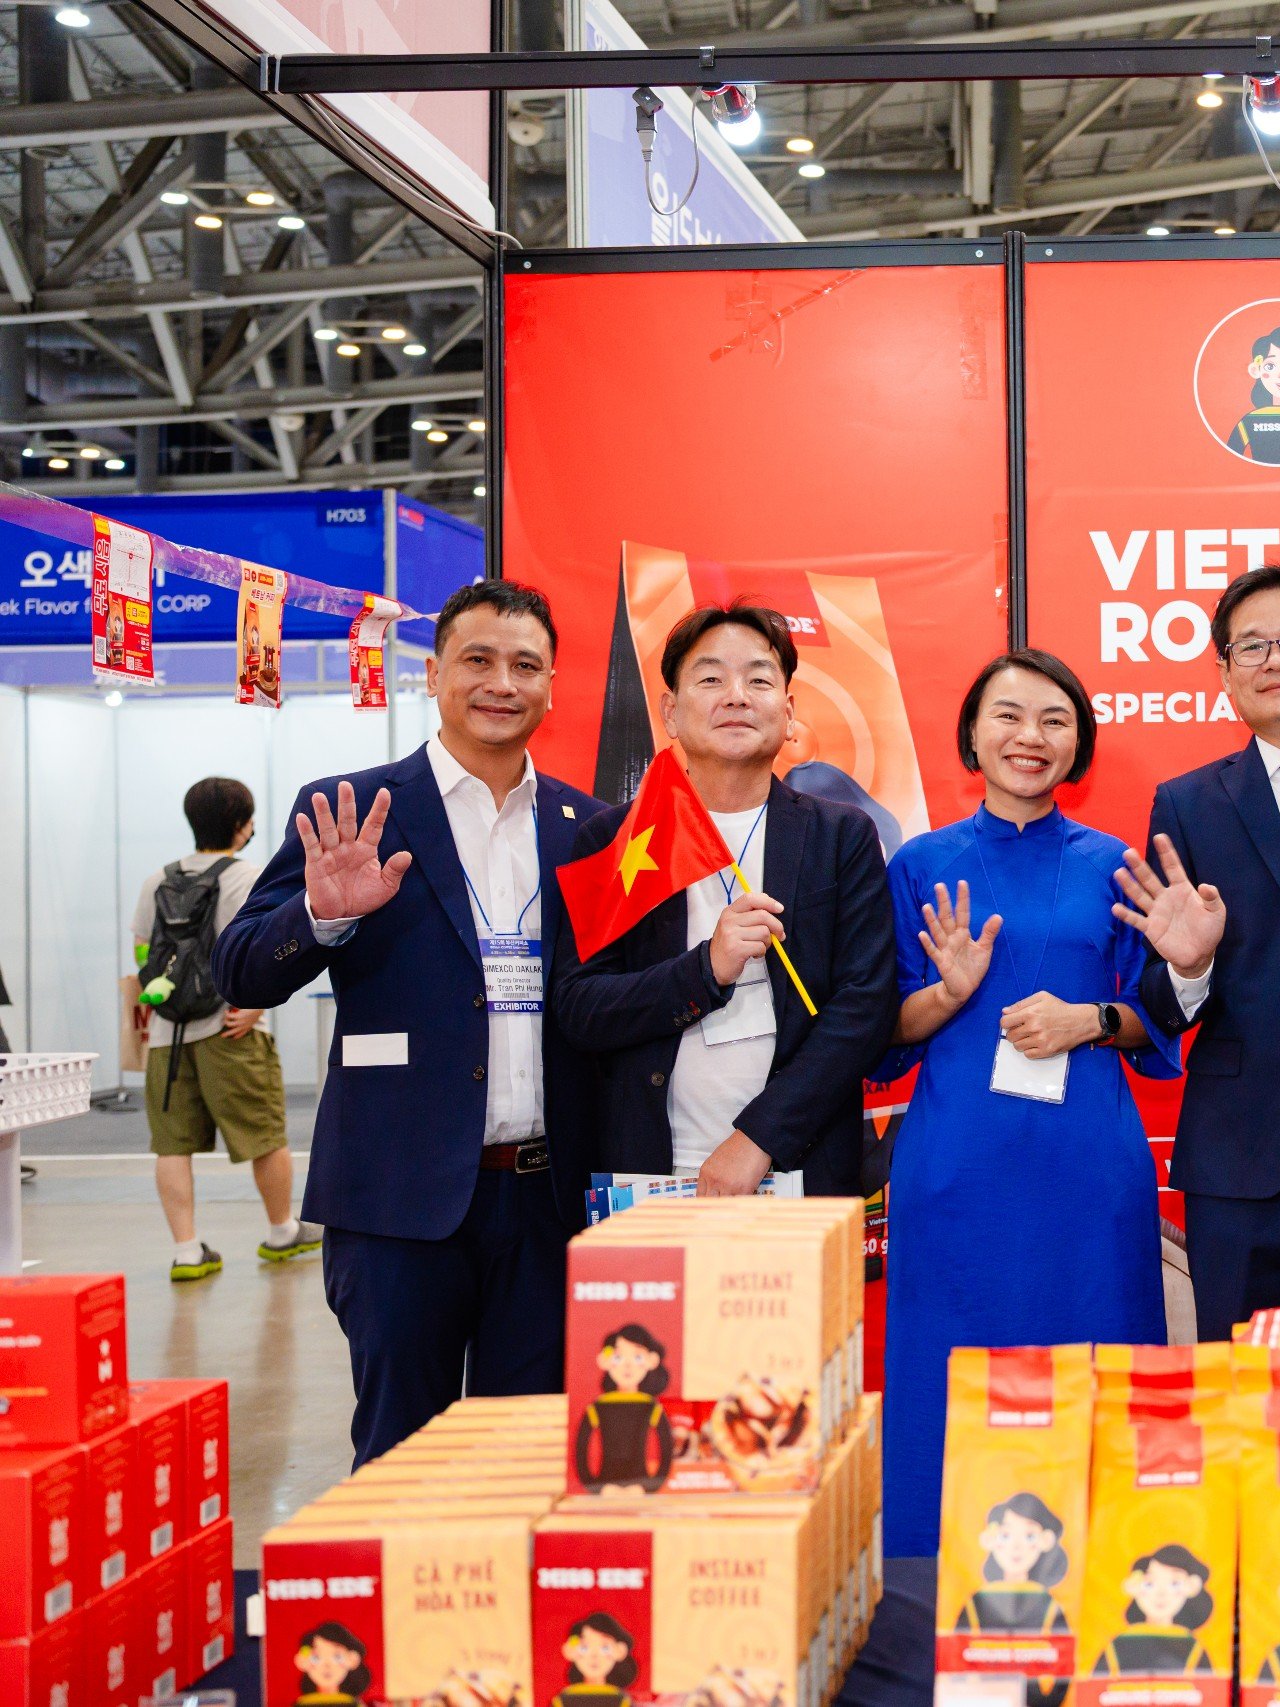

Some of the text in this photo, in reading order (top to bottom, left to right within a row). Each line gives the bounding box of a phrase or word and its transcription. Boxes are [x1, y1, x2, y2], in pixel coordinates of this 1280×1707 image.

[1253, 421, 1280, 431] MISS
[326, 507, 367, 523] H703
[24, 598, 79, 616] Flavor
[157, 594, 211, 614] CORP
[1094, 692, 1243, 723] SPECIA
[526, 985, 543, 993] Hung
[493, 1002, 539, 1011] EXHIBITOR
[719, 1272, 794, 1292] INSTANT
[719, 1298, 788, 1319] COFFEE
[689, 1557, 767, 1579] INSTANT
[689, 1586, 761, 1607] COFFEE
